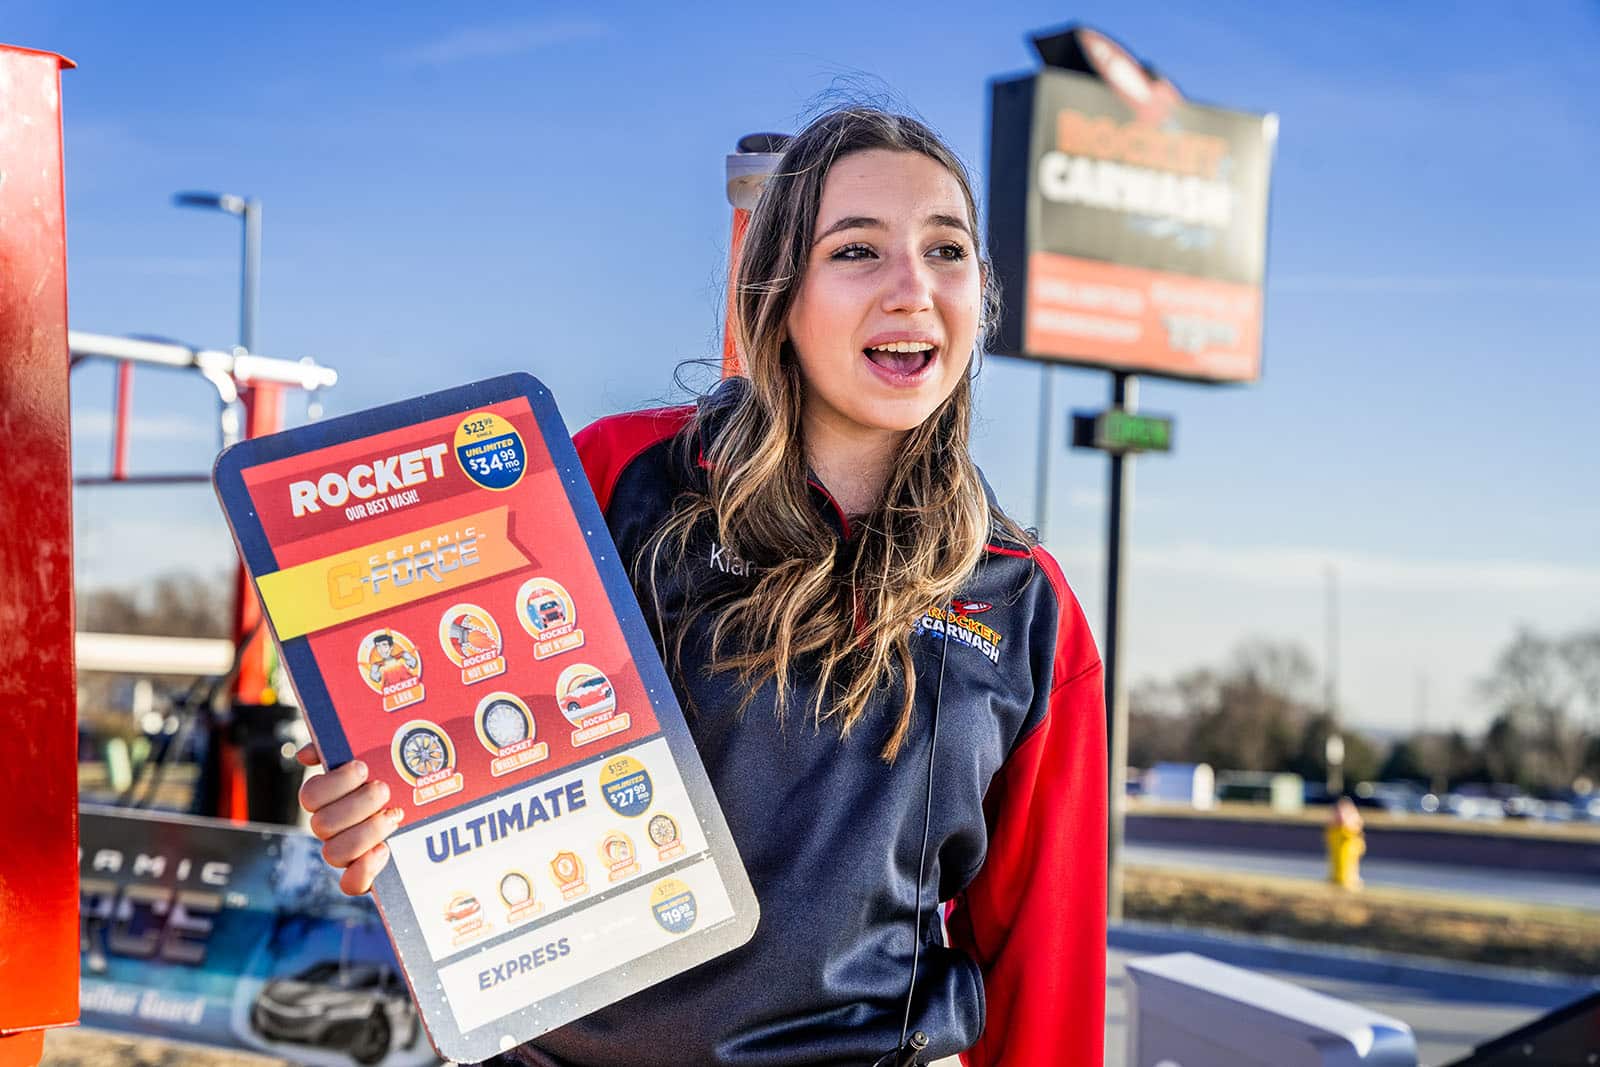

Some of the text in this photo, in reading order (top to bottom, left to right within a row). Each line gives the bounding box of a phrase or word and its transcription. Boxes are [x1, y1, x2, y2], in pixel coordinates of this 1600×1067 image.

[466, 439, 514, 457] UNLIMITED
[289, 444, 449, 518] ROCKET
[345, 491, 420, 521] OUR BEST WASH!
[368, 527, 476, 565] CERAMIC
[540, 624, 573, 640] ROCKET
[928, 607, 1001, 646] ROCKET
[922, 616, 1000, 664] CARWASH
[463, 652, 498, 667] ROCKET
[384, 677, 418, 695] ROCKET
[582, 711, 613, 728] ROCKET
[499, 740, 533, 756] ROCKET
[417, 769, 452, 786] ROCKET
[426, 779, 587, 863] ULTIMATE
[478, 937, 571, 991] EXPRESS
